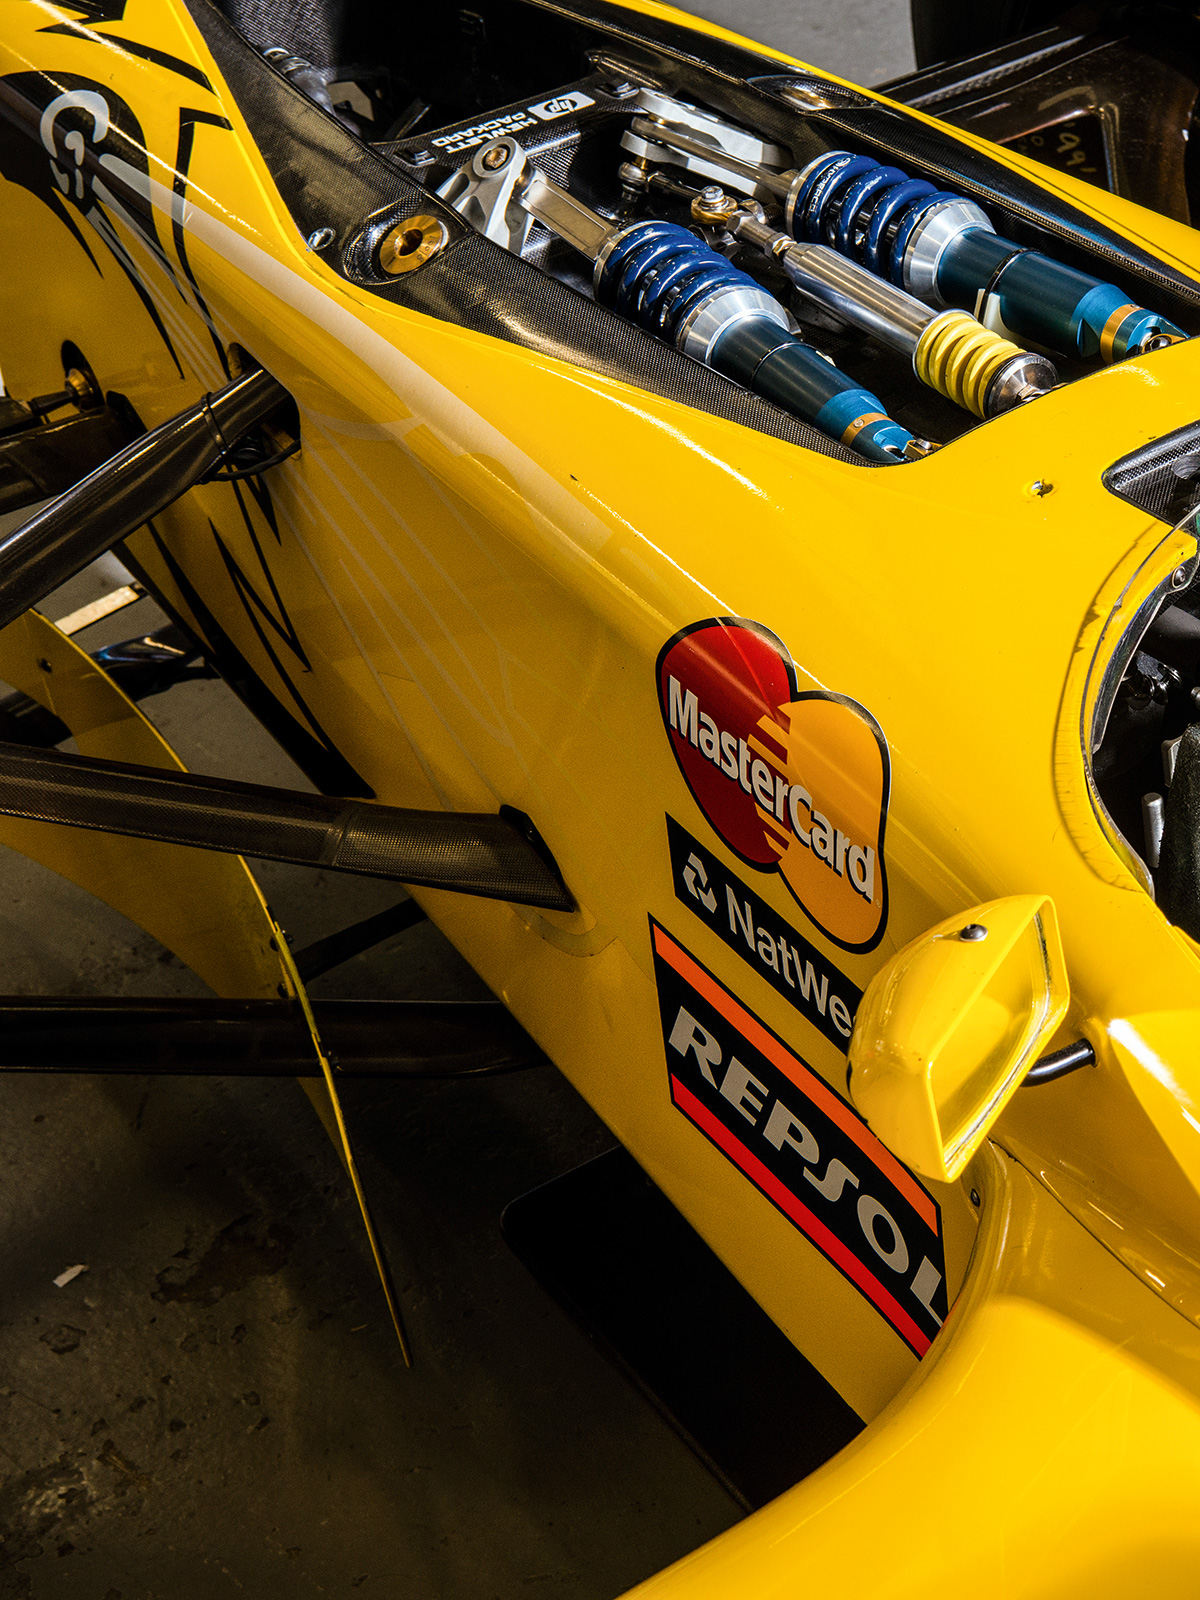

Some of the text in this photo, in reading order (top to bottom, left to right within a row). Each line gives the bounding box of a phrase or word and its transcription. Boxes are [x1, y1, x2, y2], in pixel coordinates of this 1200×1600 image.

[431, 112, 526, 147] PACKARD
[446, 117, 538, 153] HEWLETT
[668, 674, 876, 902] MasterCard
[725, 883, 855, 1038] NatWe
[668, 1005, 944, 1328] REPSOL
